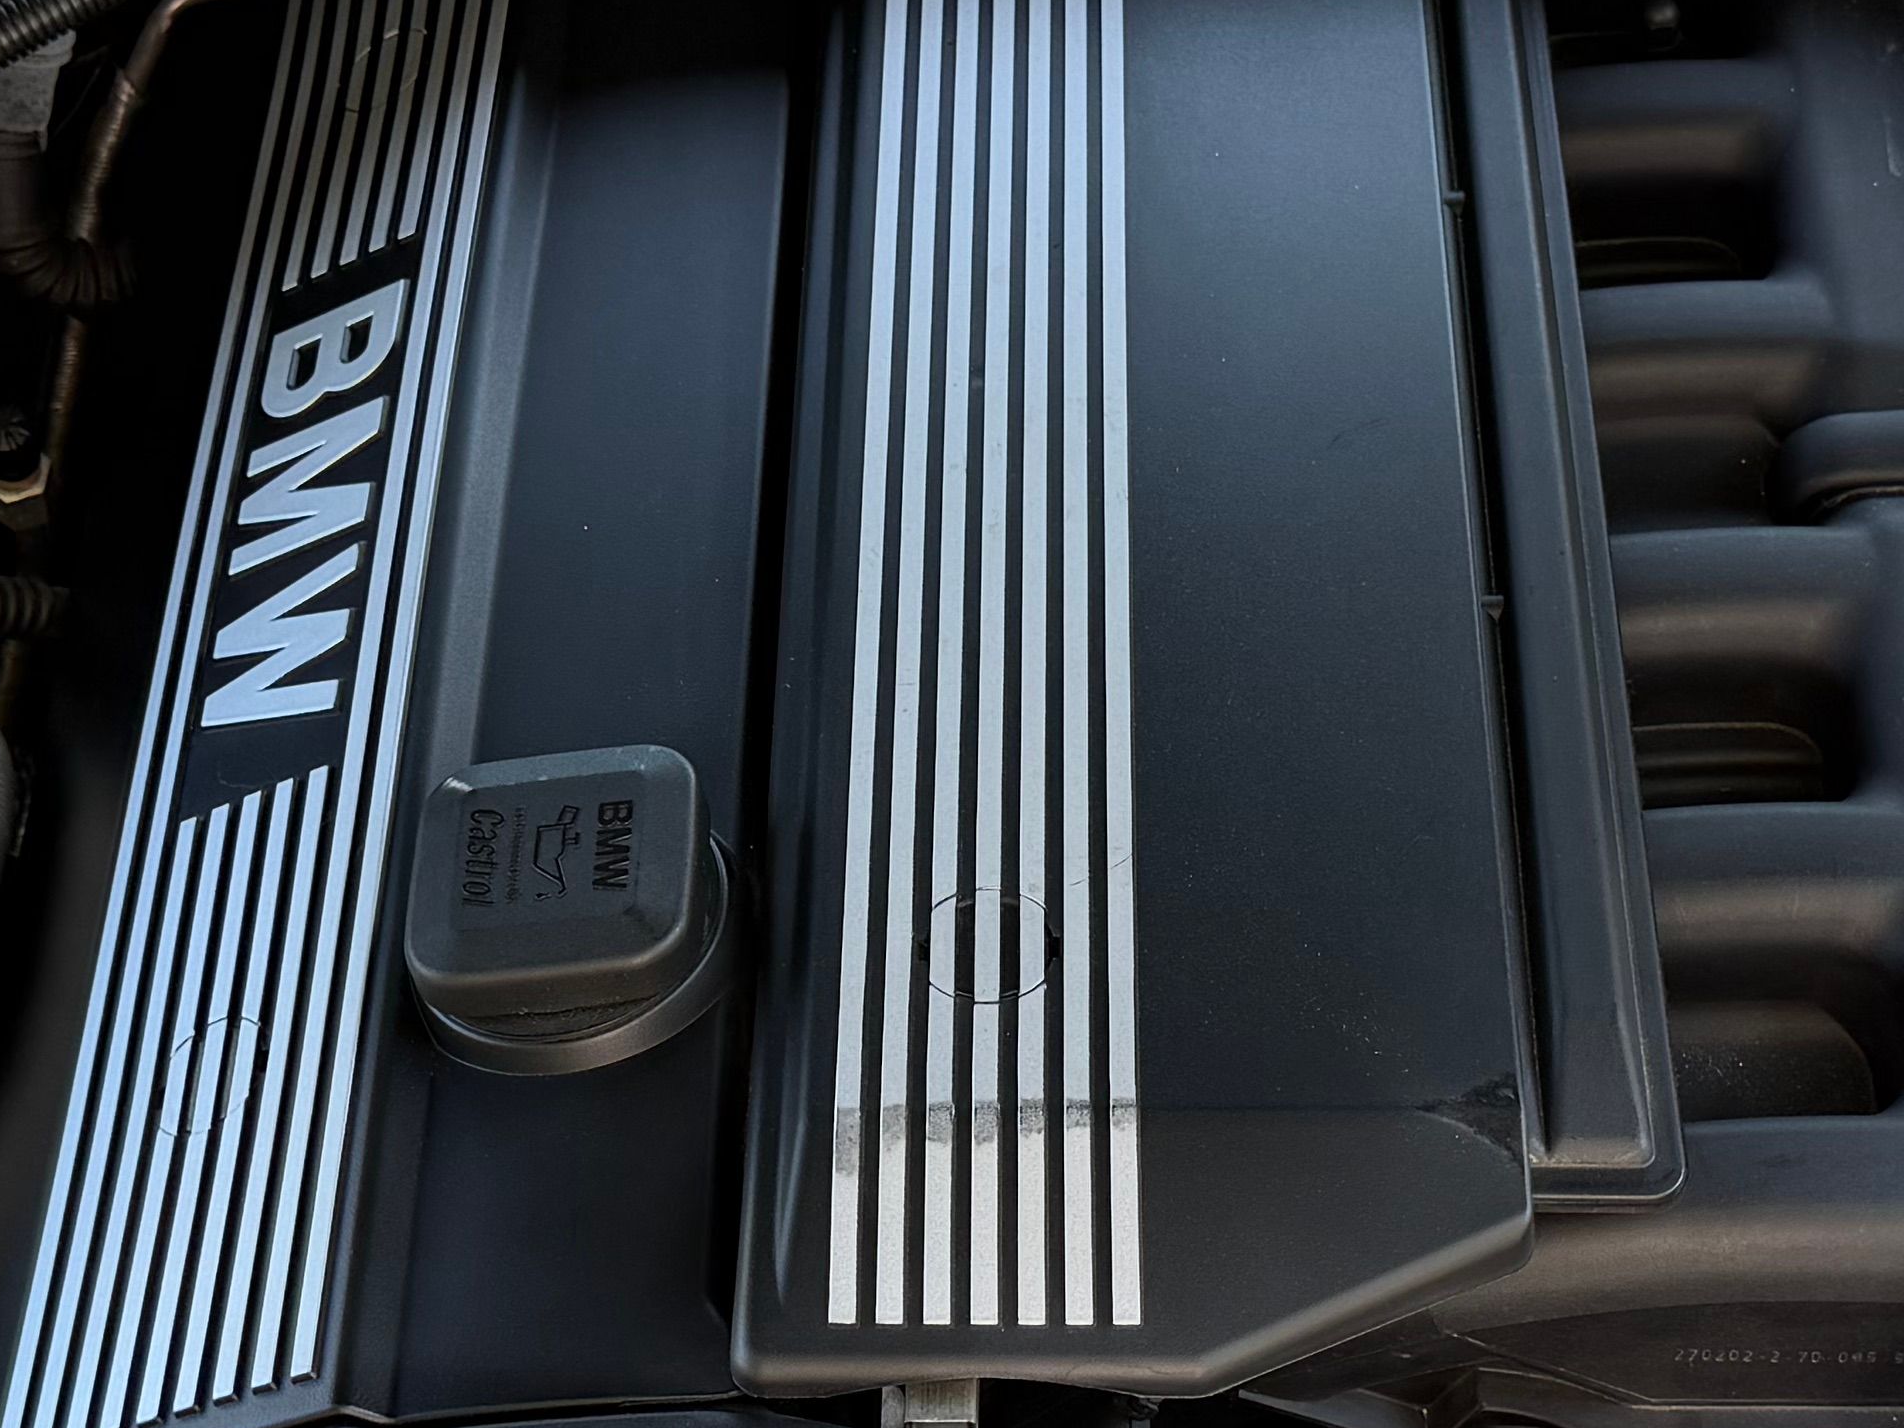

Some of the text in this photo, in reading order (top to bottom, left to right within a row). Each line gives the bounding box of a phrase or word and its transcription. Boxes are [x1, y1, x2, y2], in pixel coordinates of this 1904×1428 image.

[199, 275, 407, 730] BMW
[462, 809, 505, 907] Castrol
[592, 800, 633, 891] BMW
